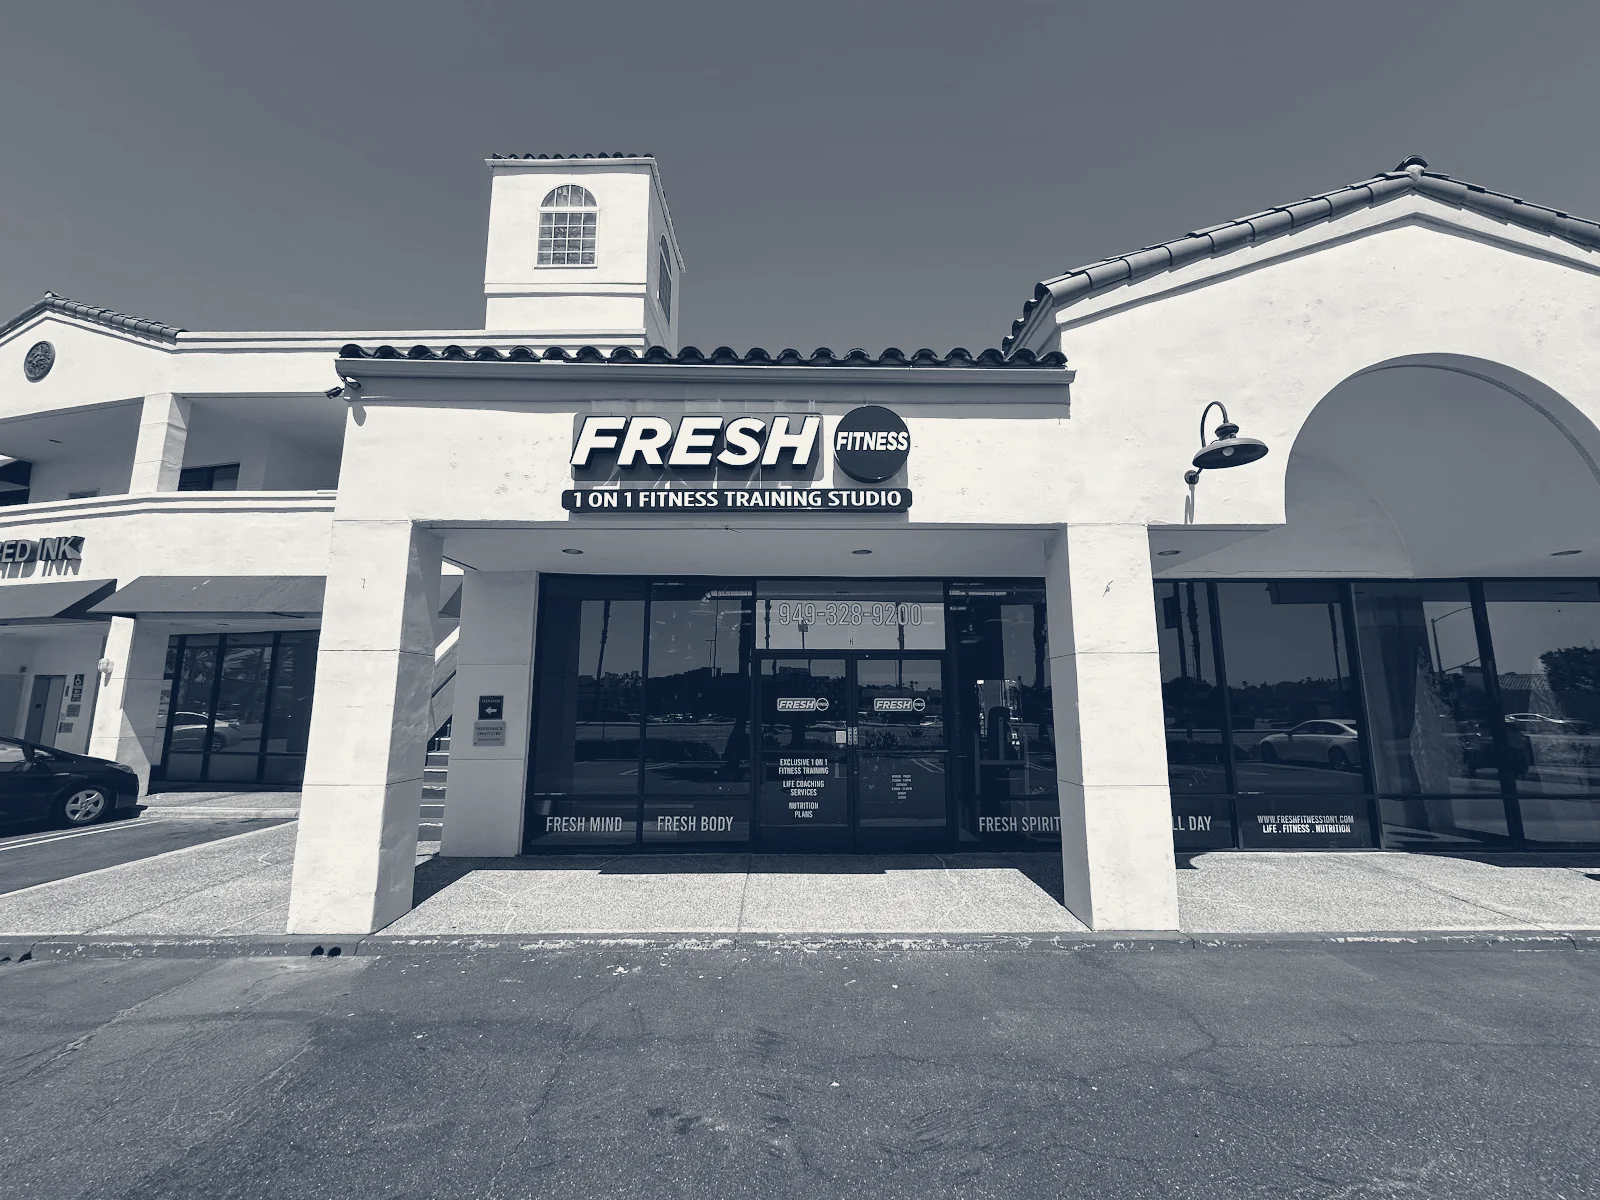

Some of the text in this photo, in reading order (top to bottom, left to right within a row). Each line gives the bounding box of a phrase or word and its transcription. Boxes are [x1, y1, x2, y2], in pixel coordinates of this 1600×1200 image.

[570, 416, 819, 466] FRESH
[836, 431, 908, 450] FITNESS
[573, 491, 902, 507] 1 ON 1 FITNESS TRAINING STUDIO
[0, 537, 82, 563] ED INK
[779, 603, 922, 626] 949-328-9200
[779, 701, 815, 709] FRESH
[876, 701, 911, 709] FRESH
[779, 758, 810, 767] EXCLUSIVE
[815, 758, 824, 767] ON
[778, 767, 829, 775] FITNESS TRAINING
[782, 780, 825, 788] LIFE COACHING
[790, 788, 818, 797] SERVICES
[788, 801, 819, 810] NUTRITION
[794, 810, 813, 819] PLANS
[546, 816, 623, 832] FRESH MIND
[657, 815, 734, 831] FRESH BODY
[979, 816, 1061, 832] FRESH SPIRIT
[1188, 815, 1212, 832] DAY
[1262, 824, 1278, 833] LIFE
[1282, 824, 1310, 833] FITNESS
[1315, 824, 1351, 833] NUTRITION
